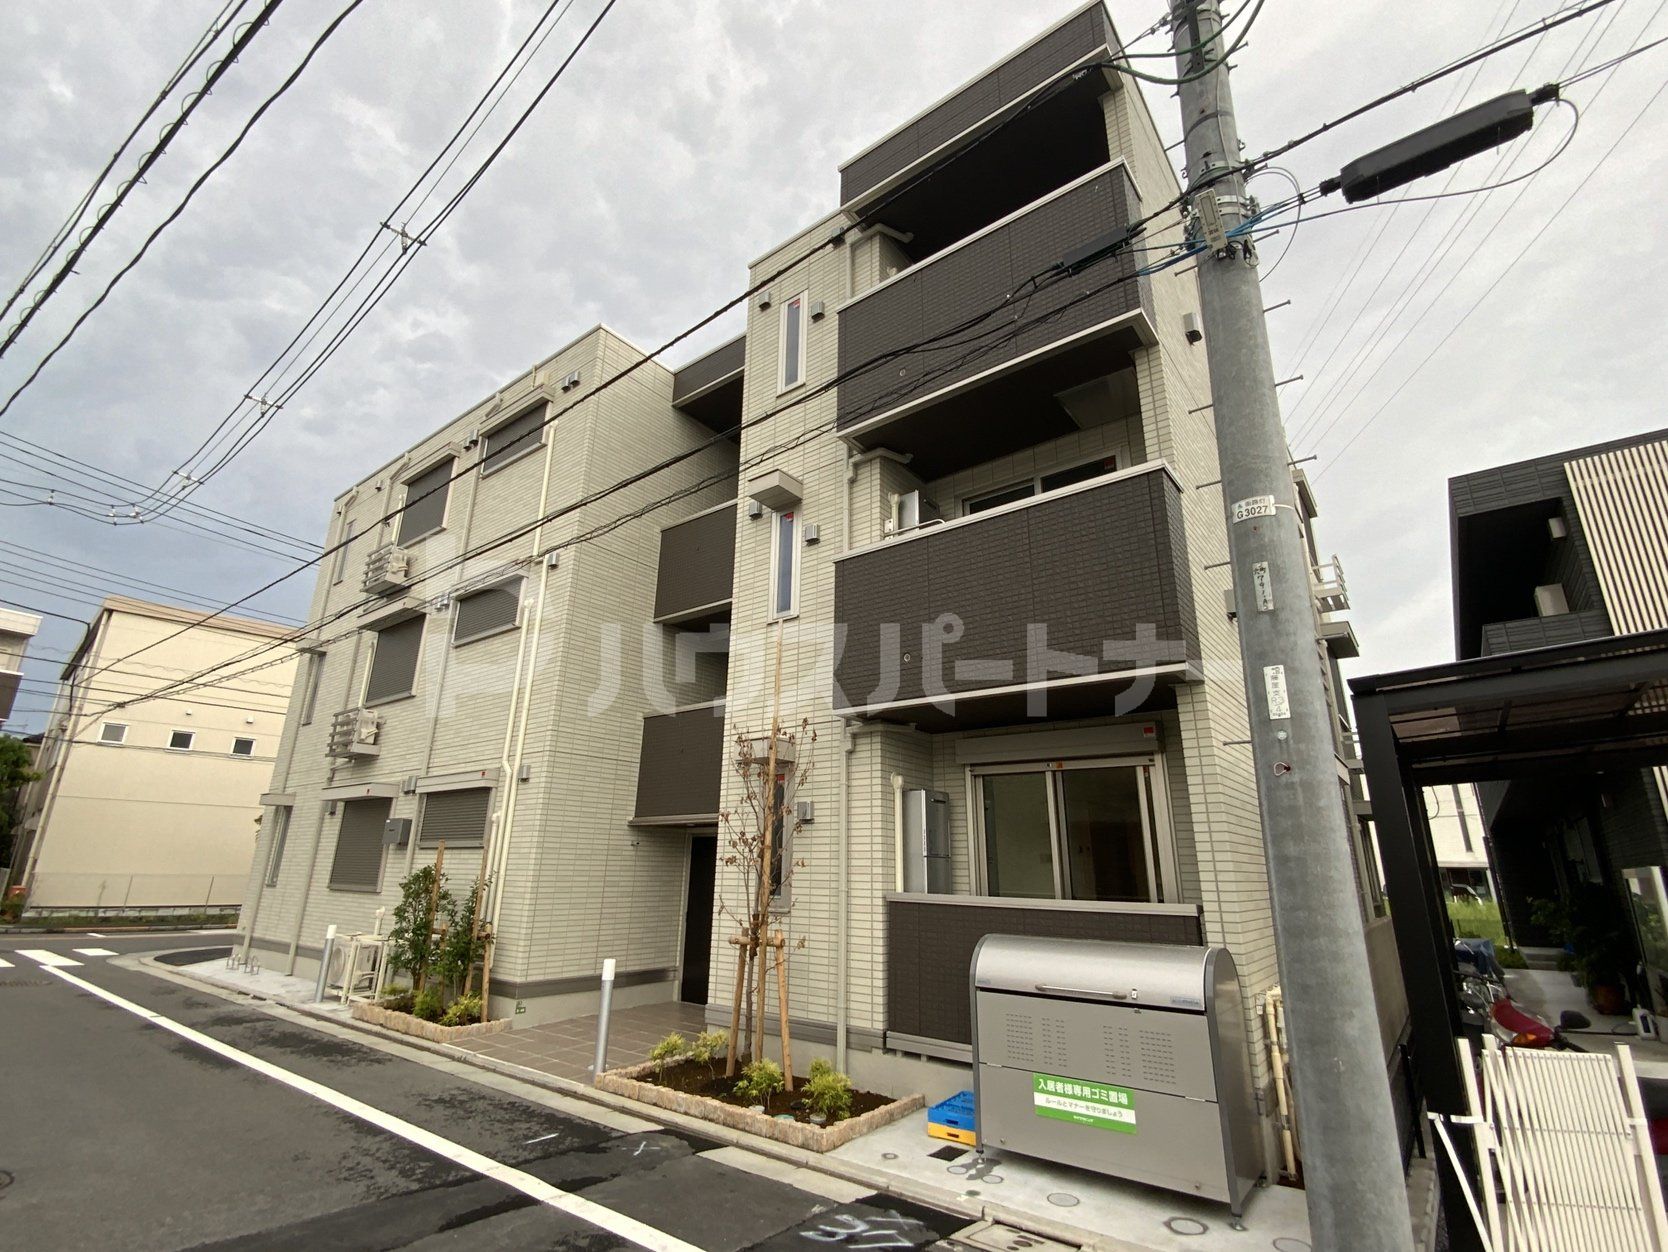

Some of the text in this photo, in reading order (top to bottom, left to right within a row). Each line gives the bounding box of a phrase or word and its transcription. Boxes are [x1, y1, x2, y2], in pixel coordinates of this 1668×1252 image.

[1236, 505, 1268, 520] G3027
[1038, 1078, 1128, 1105] 入居者様専用ゴミ置場
[1045, 1097, 1123, 1118] ルールとマナーを守りましょう
